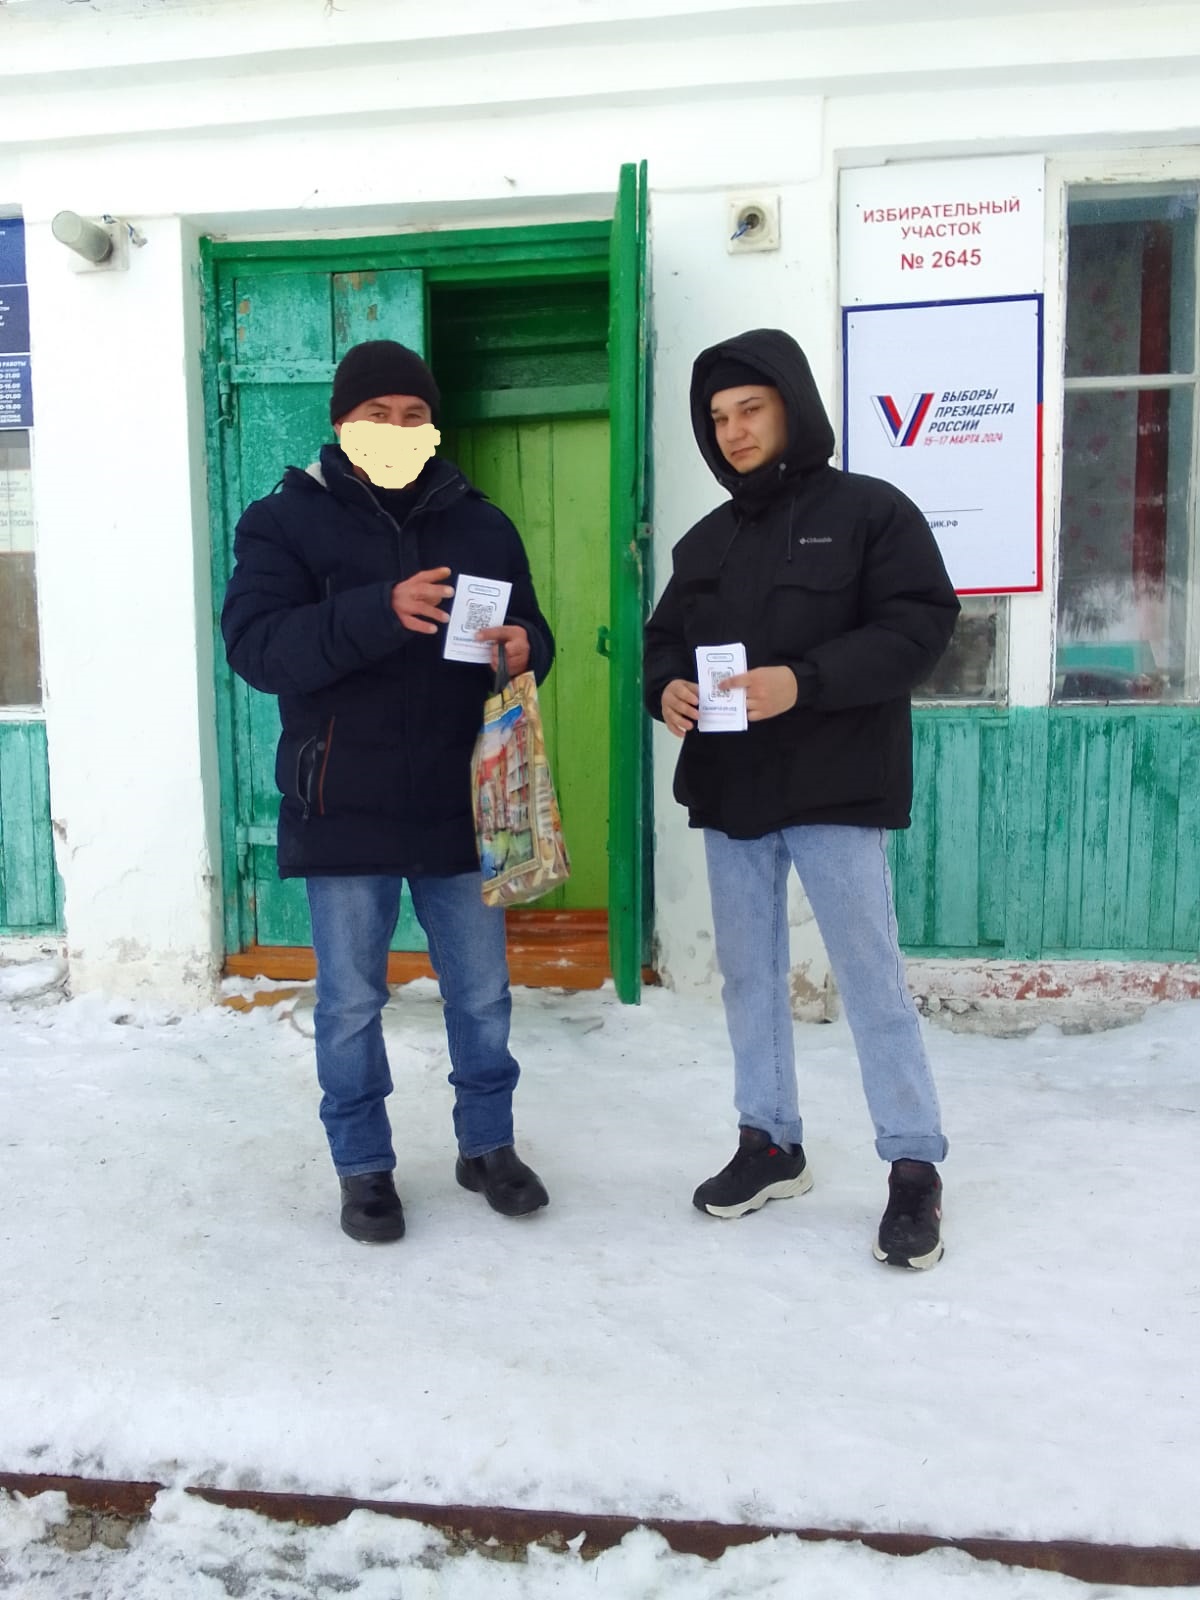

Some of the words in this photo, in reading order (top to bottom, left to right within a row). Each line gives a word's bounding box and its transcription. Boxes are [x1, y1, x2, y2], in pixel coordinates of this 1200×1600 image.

[863, 196, 1021, 223] ИЗБИРАТЕЛЬНЫЙ
[901, 221, 982, 240] УЧАСТОК
[901, 253, 924, 270] №
[932, 248, 982, 269] 2645
[941, 388, 998, 403] ВЫБОРЫ
[934, 403, 1015, 418] ПРЕЗИДЕНТА
[928, 420, 980, 433] РОССИИ
[949, 434, 979, 445] МАРТА
[981, 433, 1003, 443] 2024
